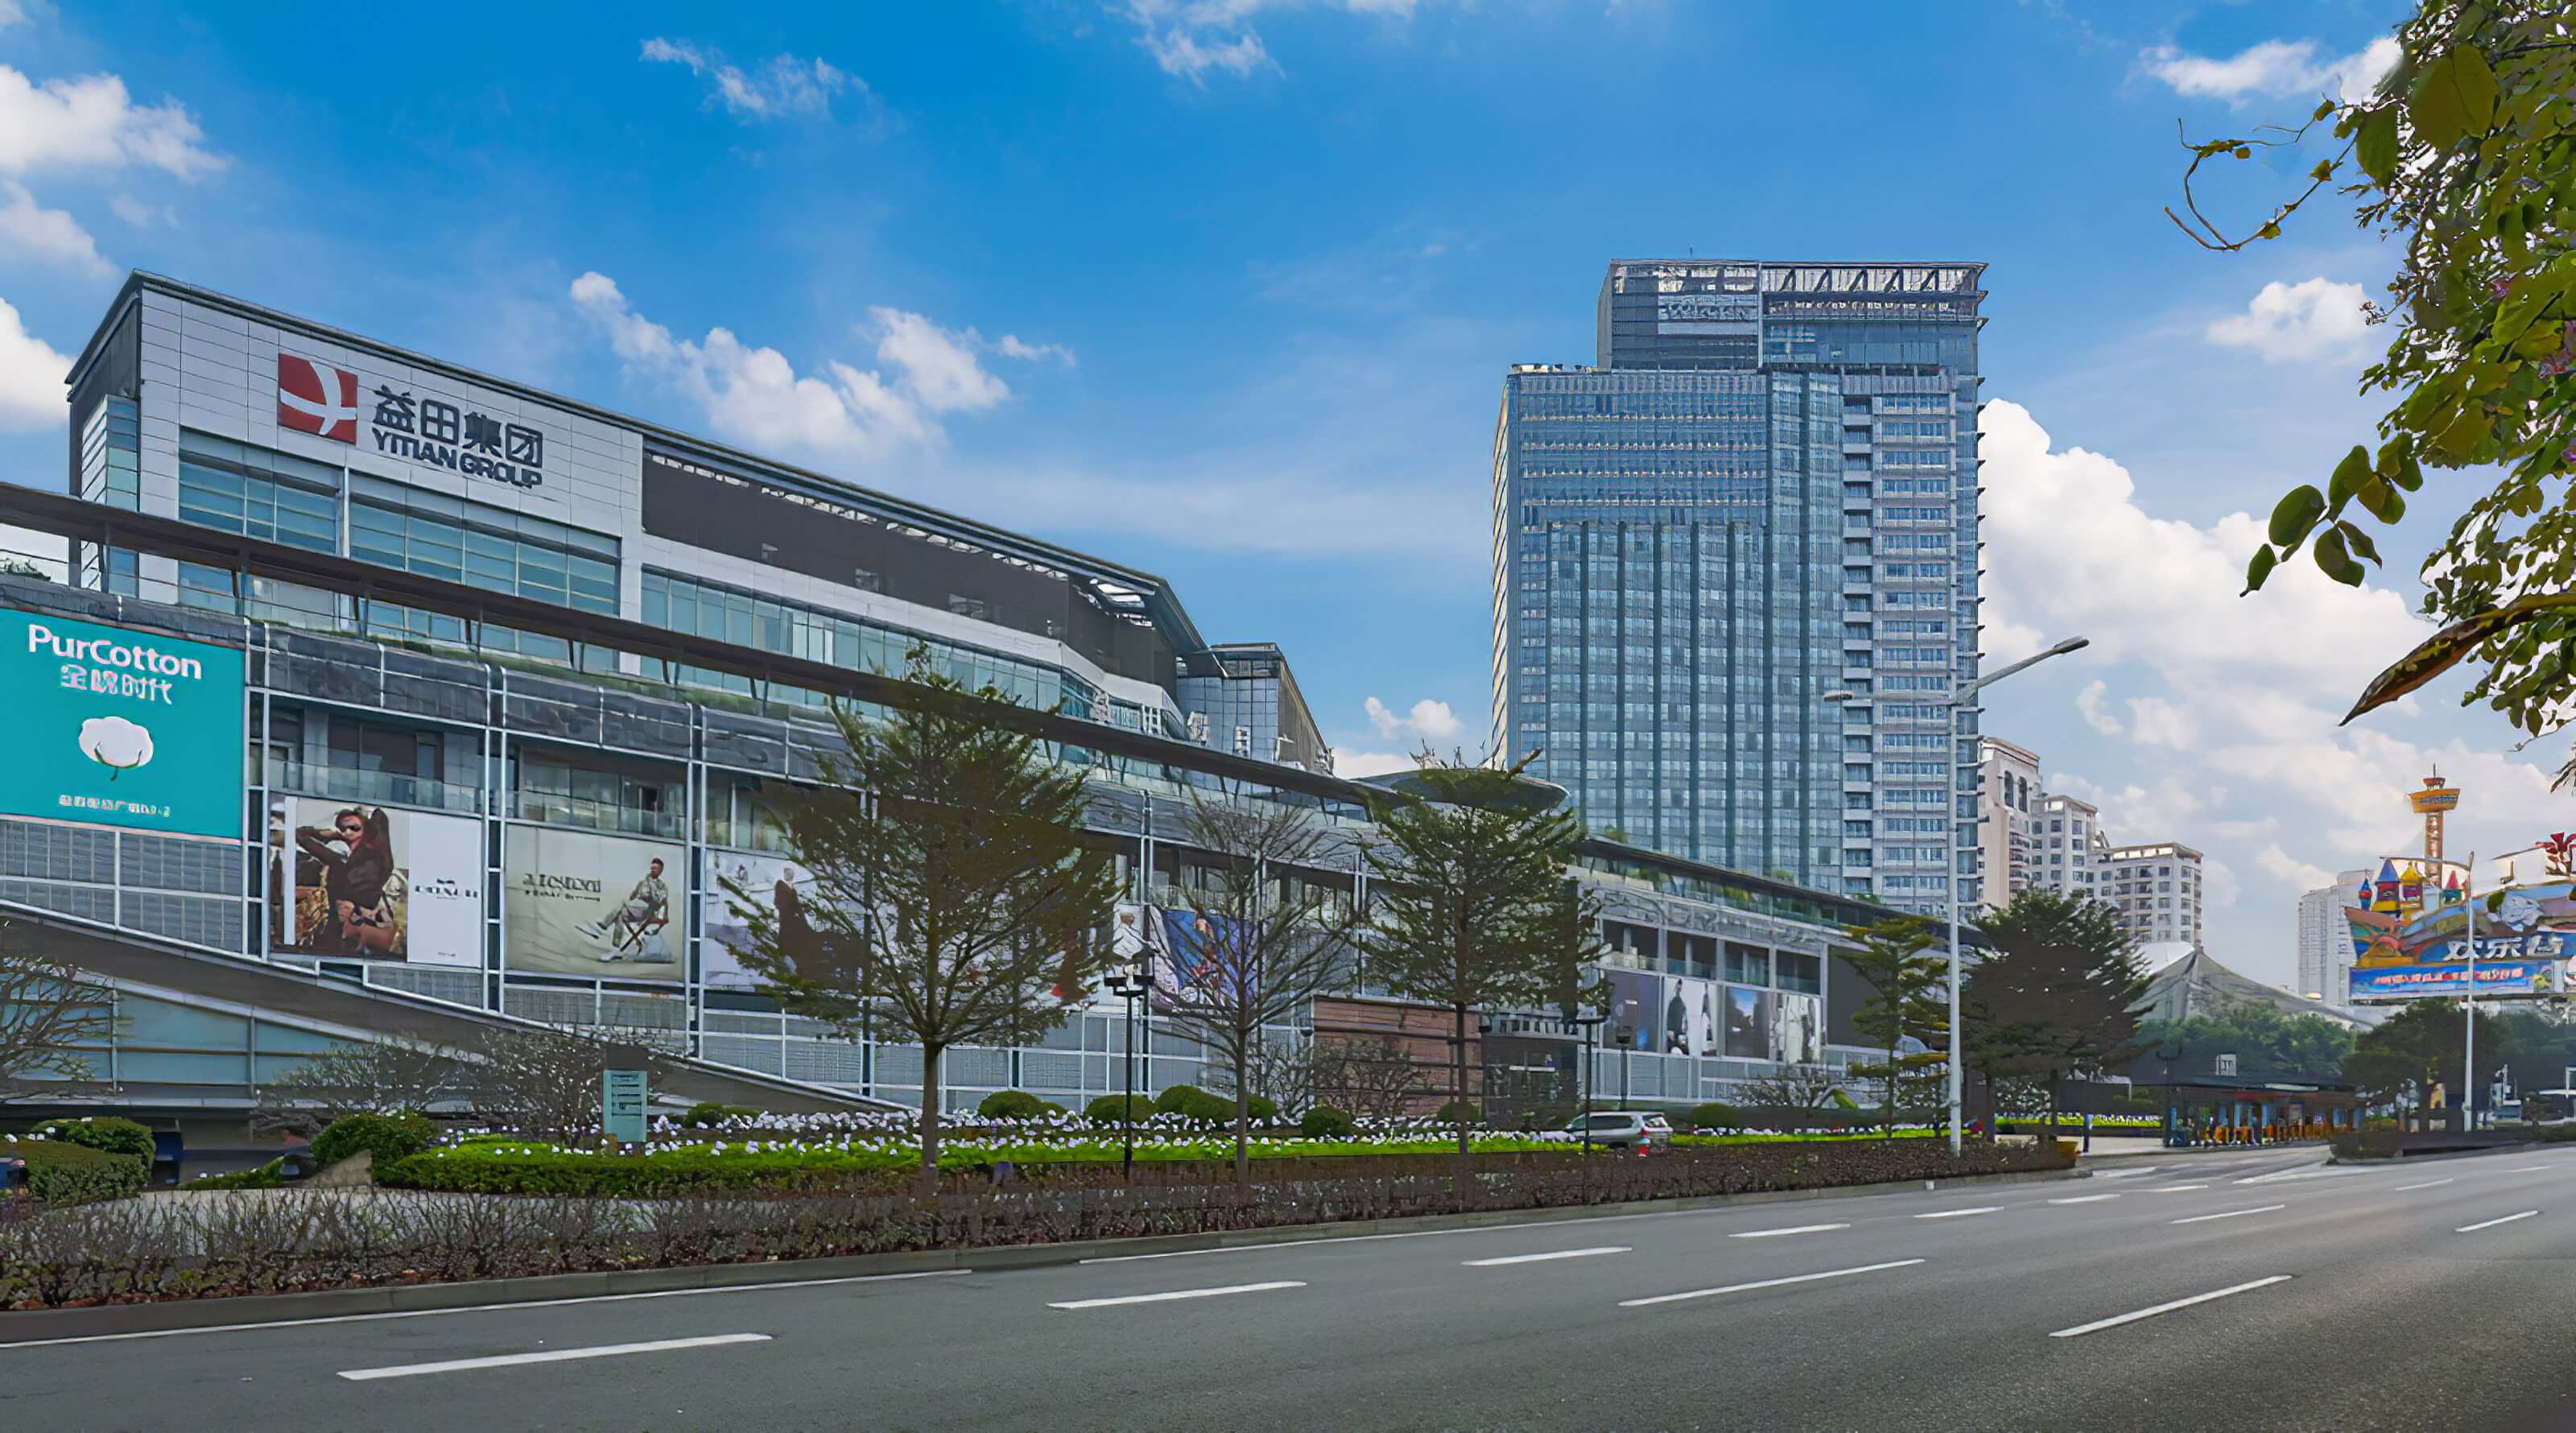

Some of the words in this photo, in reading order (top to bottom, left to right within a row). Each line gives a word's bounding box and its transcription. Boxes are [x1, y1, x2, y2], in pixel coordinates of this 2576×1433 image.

[373, 384, 543, 469] 益田集团
[372, 427, 457, 470] YITIAN
[460, 452, 543, 489] GROUP
[28, 623, 202, 679] PurCotton
